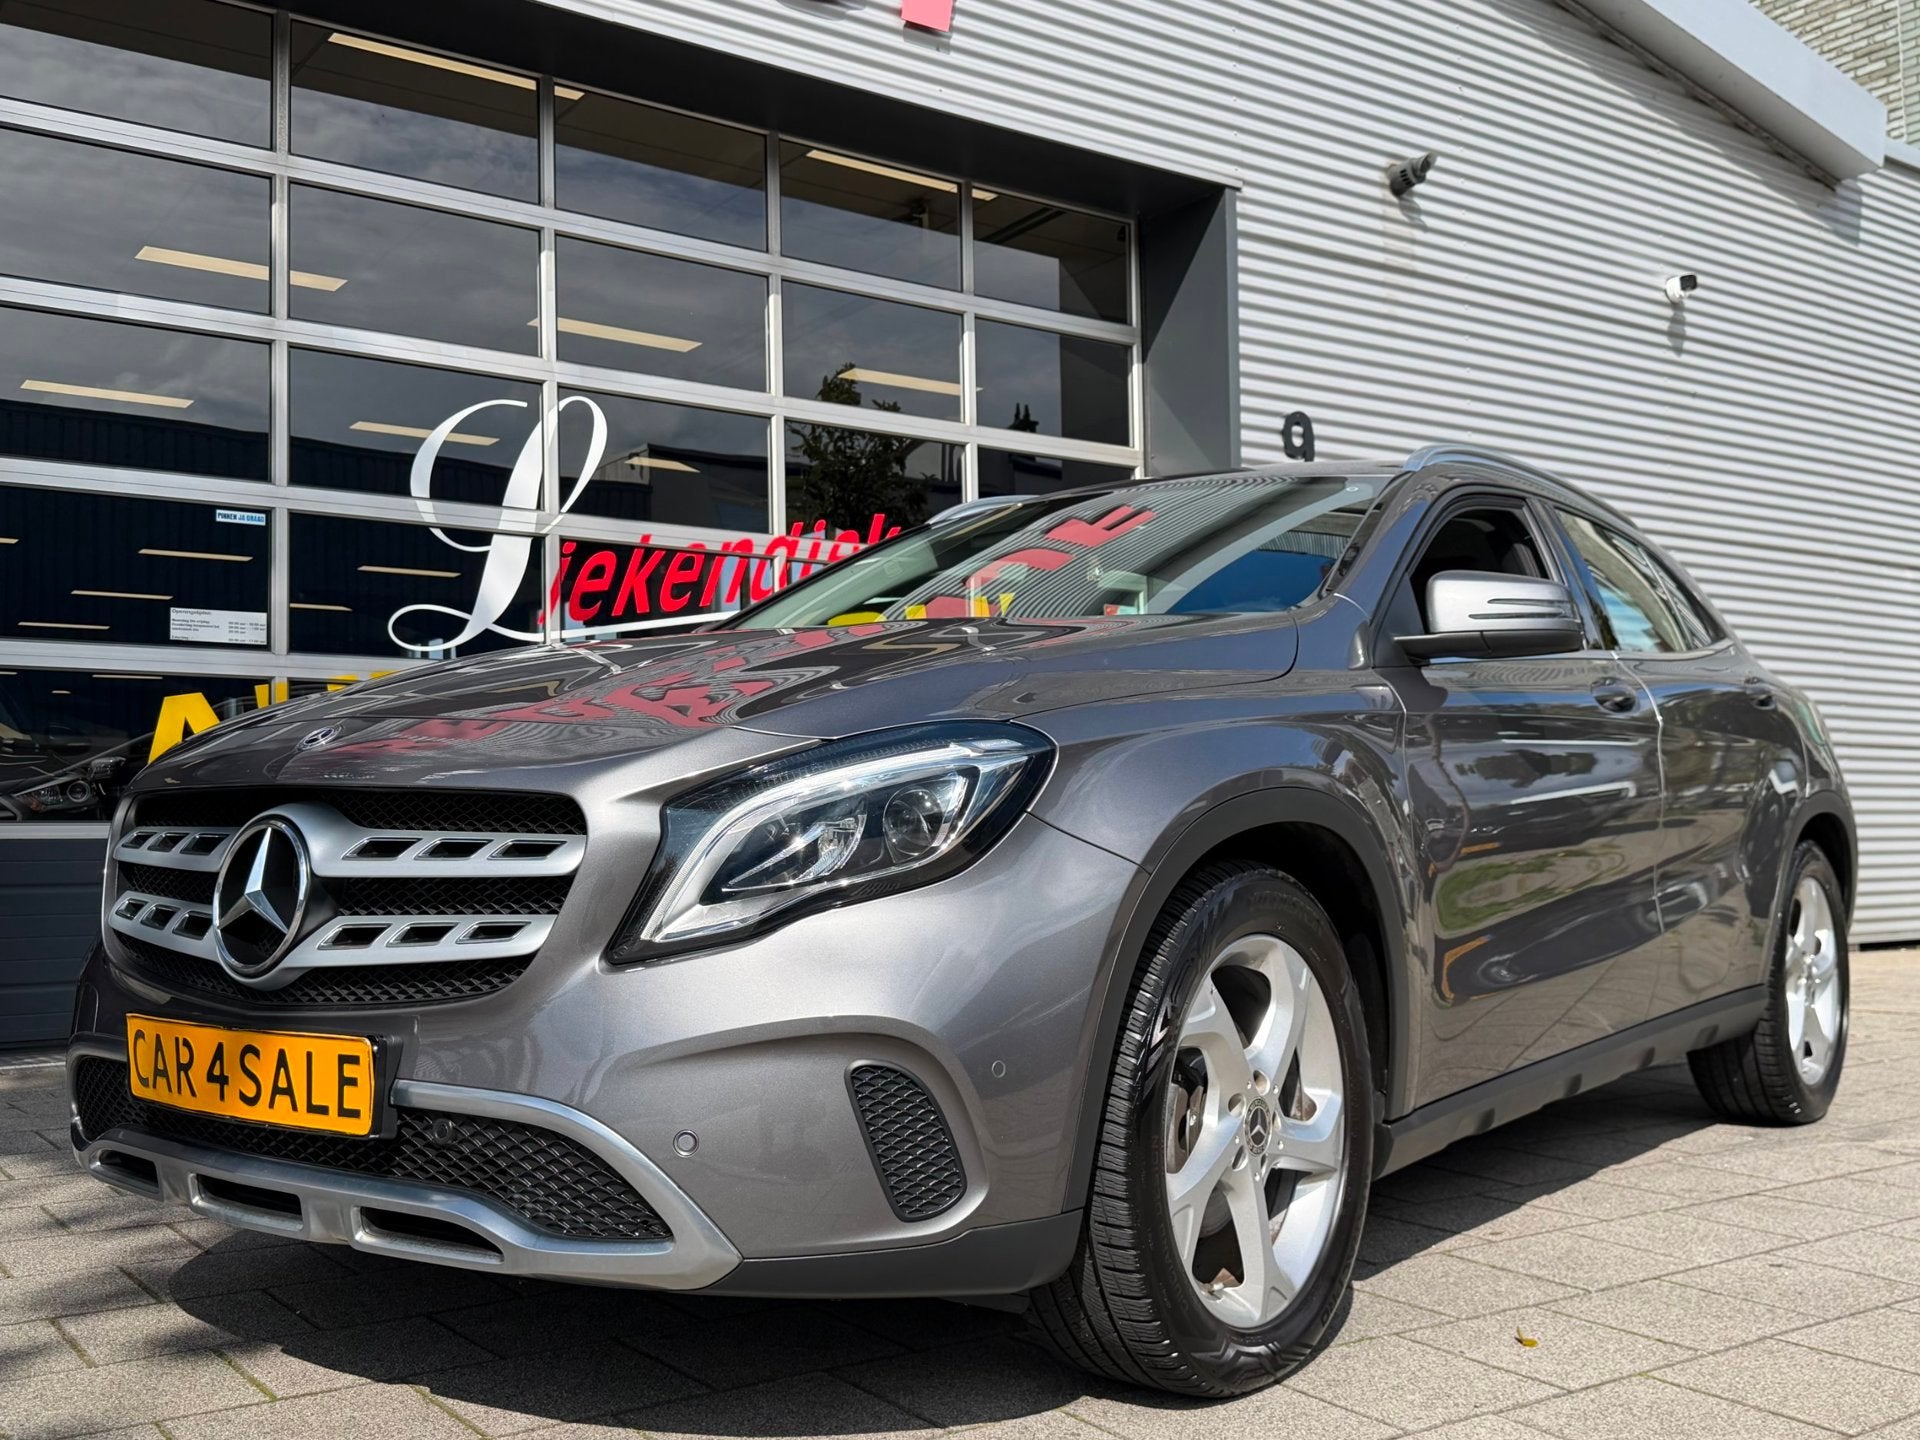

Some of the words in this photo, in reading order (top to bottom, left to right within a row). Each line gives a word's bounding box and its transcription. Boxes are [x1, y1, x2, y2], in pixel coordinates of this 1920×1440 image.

[1282, 411, 1315, 462] 9
[133, 1029, 197, 1098] CAR
[206, 1042, 230, 1102] 4
[239, 1044, 361, 1119] SALE
